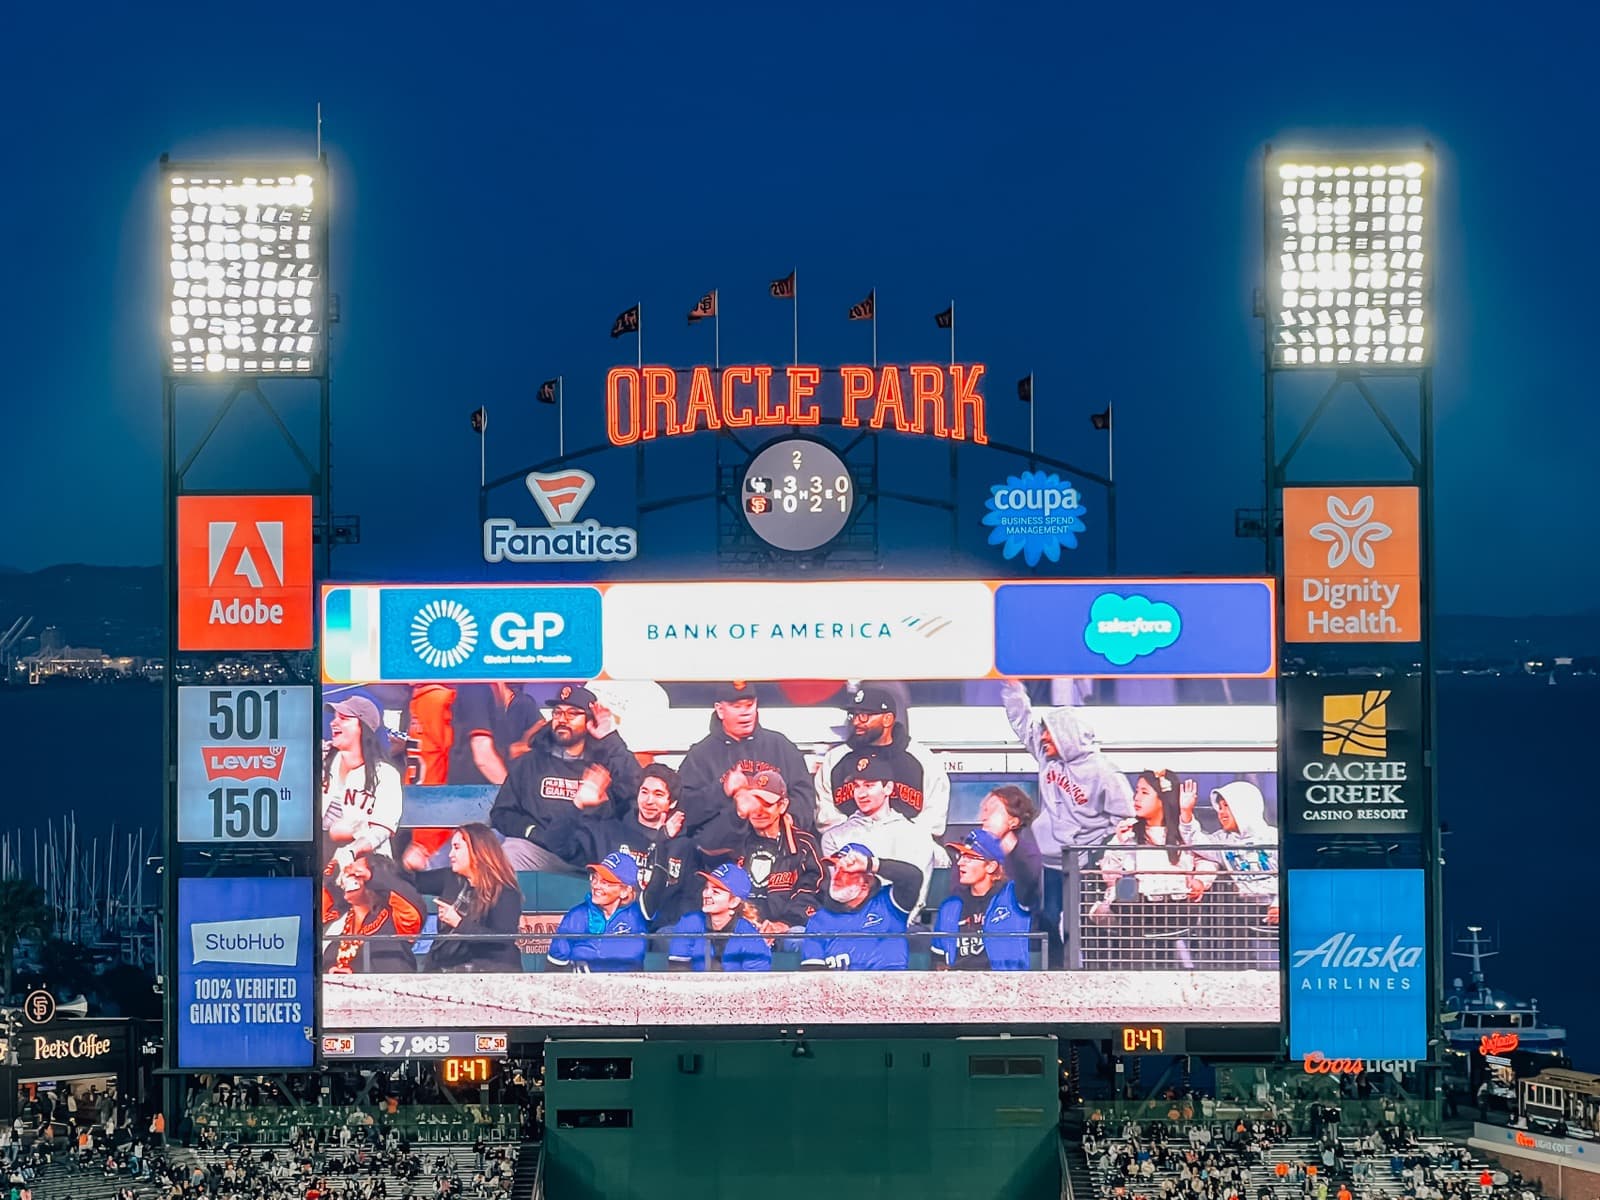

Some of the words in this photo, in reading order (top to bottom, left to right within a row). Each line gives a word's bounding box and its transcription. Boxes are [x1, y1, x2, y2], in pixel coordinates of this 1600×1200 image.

[607, 366, 820, 446] ORACLE
[840, 365, 988, 445] PARK
[792, 451, 802, 463] 2
[784, 476, 797, 493] 3
[810, 476, 823, 493] 3
[835, 476, 849, 493] 0
[783, 495, 797, 513] 0
[810, 495, 823, 512] 2
[837, 495, 847, 512] 1
[994, 488, 1078, 516] coupa
[1001, 516, 1043, 525] BUSINESS
[1045, 516, 1074, 525] SPEND
[1006, 525, 1069, 535] MANAGEMENT
[491, 525, 632, 555] Fanatics
[1303, 578, 1400, 609] Dignity
[208, 598, 284, 625] Adobe
[647, 624, 718, 640] BANK
[729, 623, 760, 640] OF
[770, 622, 892, 639] AMERICA
[1302, 762, 1407, 781] CACHE
[1305, 785, 1405, 804] CREEK
[1303, 810, 1353, 820] CASINO
[1357, 809, 1408, 820] RESORT
[206, 933, 285, 950] StubHub
[1293, 932, 1423, 972] Alaska
[195, 978, 233, 999] 100%
[236, 978, 297, 999] VERIFIED
[1301, 977, 1411, 990] AIRLINES
[190, 1003, 241, 1024] GIANTS
[243, 1003, 302, 1023] TICKETS
[33, 1036, 69, 1059] Peet's
[69, 1033, 110, 1059] Coffee
[1124, 1029, 1162, 1051] 0:47
[447, 1059, 489, 1082] 0:47
[1303, 1050, 1362, 1075] Coors
[1366, 1060, 1417, 1072] LIGHT
